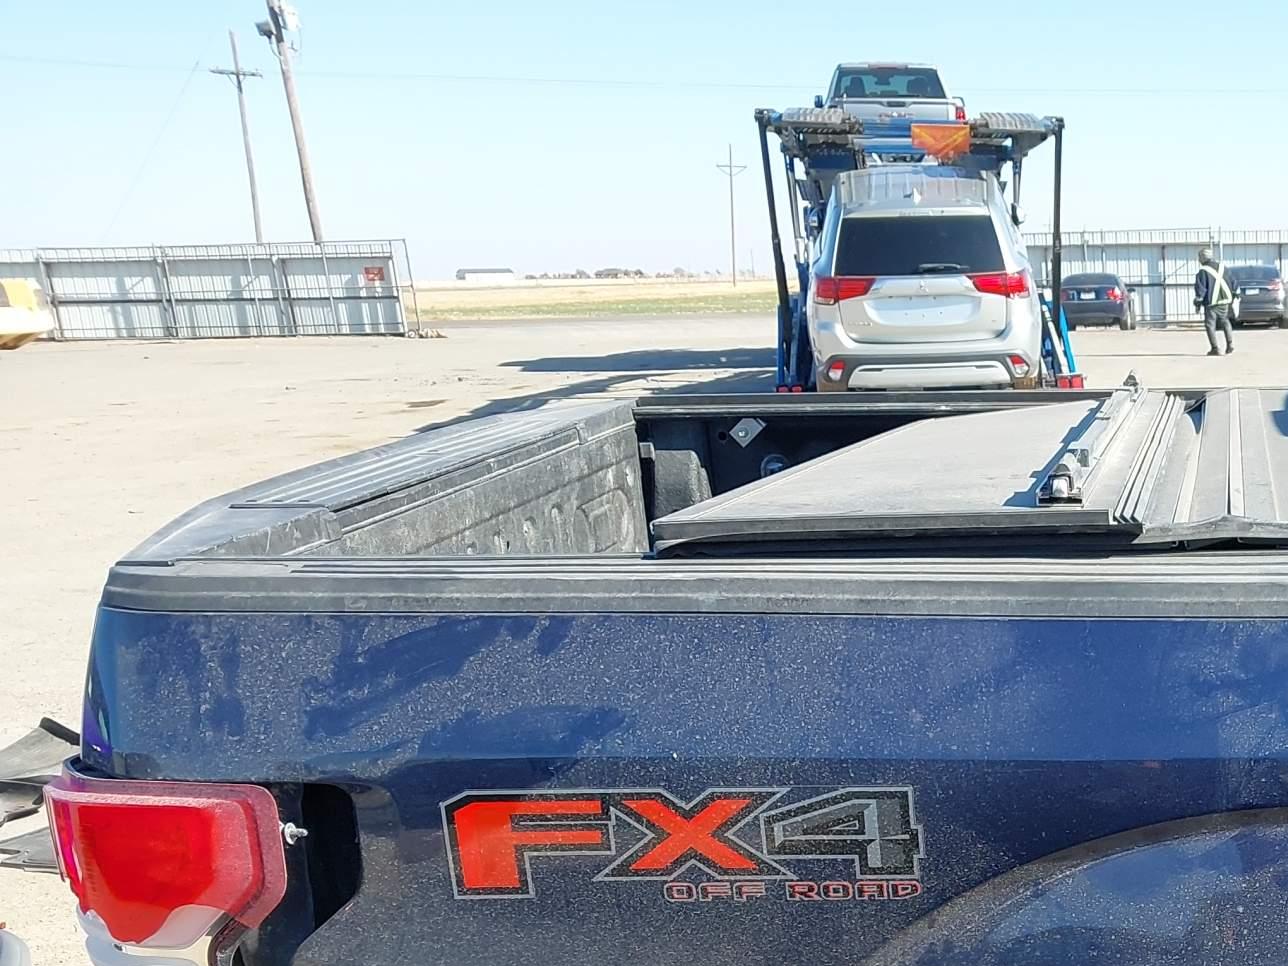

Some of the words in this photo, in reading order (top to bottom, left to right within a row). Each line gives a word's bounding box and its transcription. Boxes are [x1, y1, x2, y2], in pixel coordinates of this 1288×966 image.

[441, 786, 925, 900] FX4
[663, 880, 766, 902] OFF
[785, 880, 922, 901] ROAD
